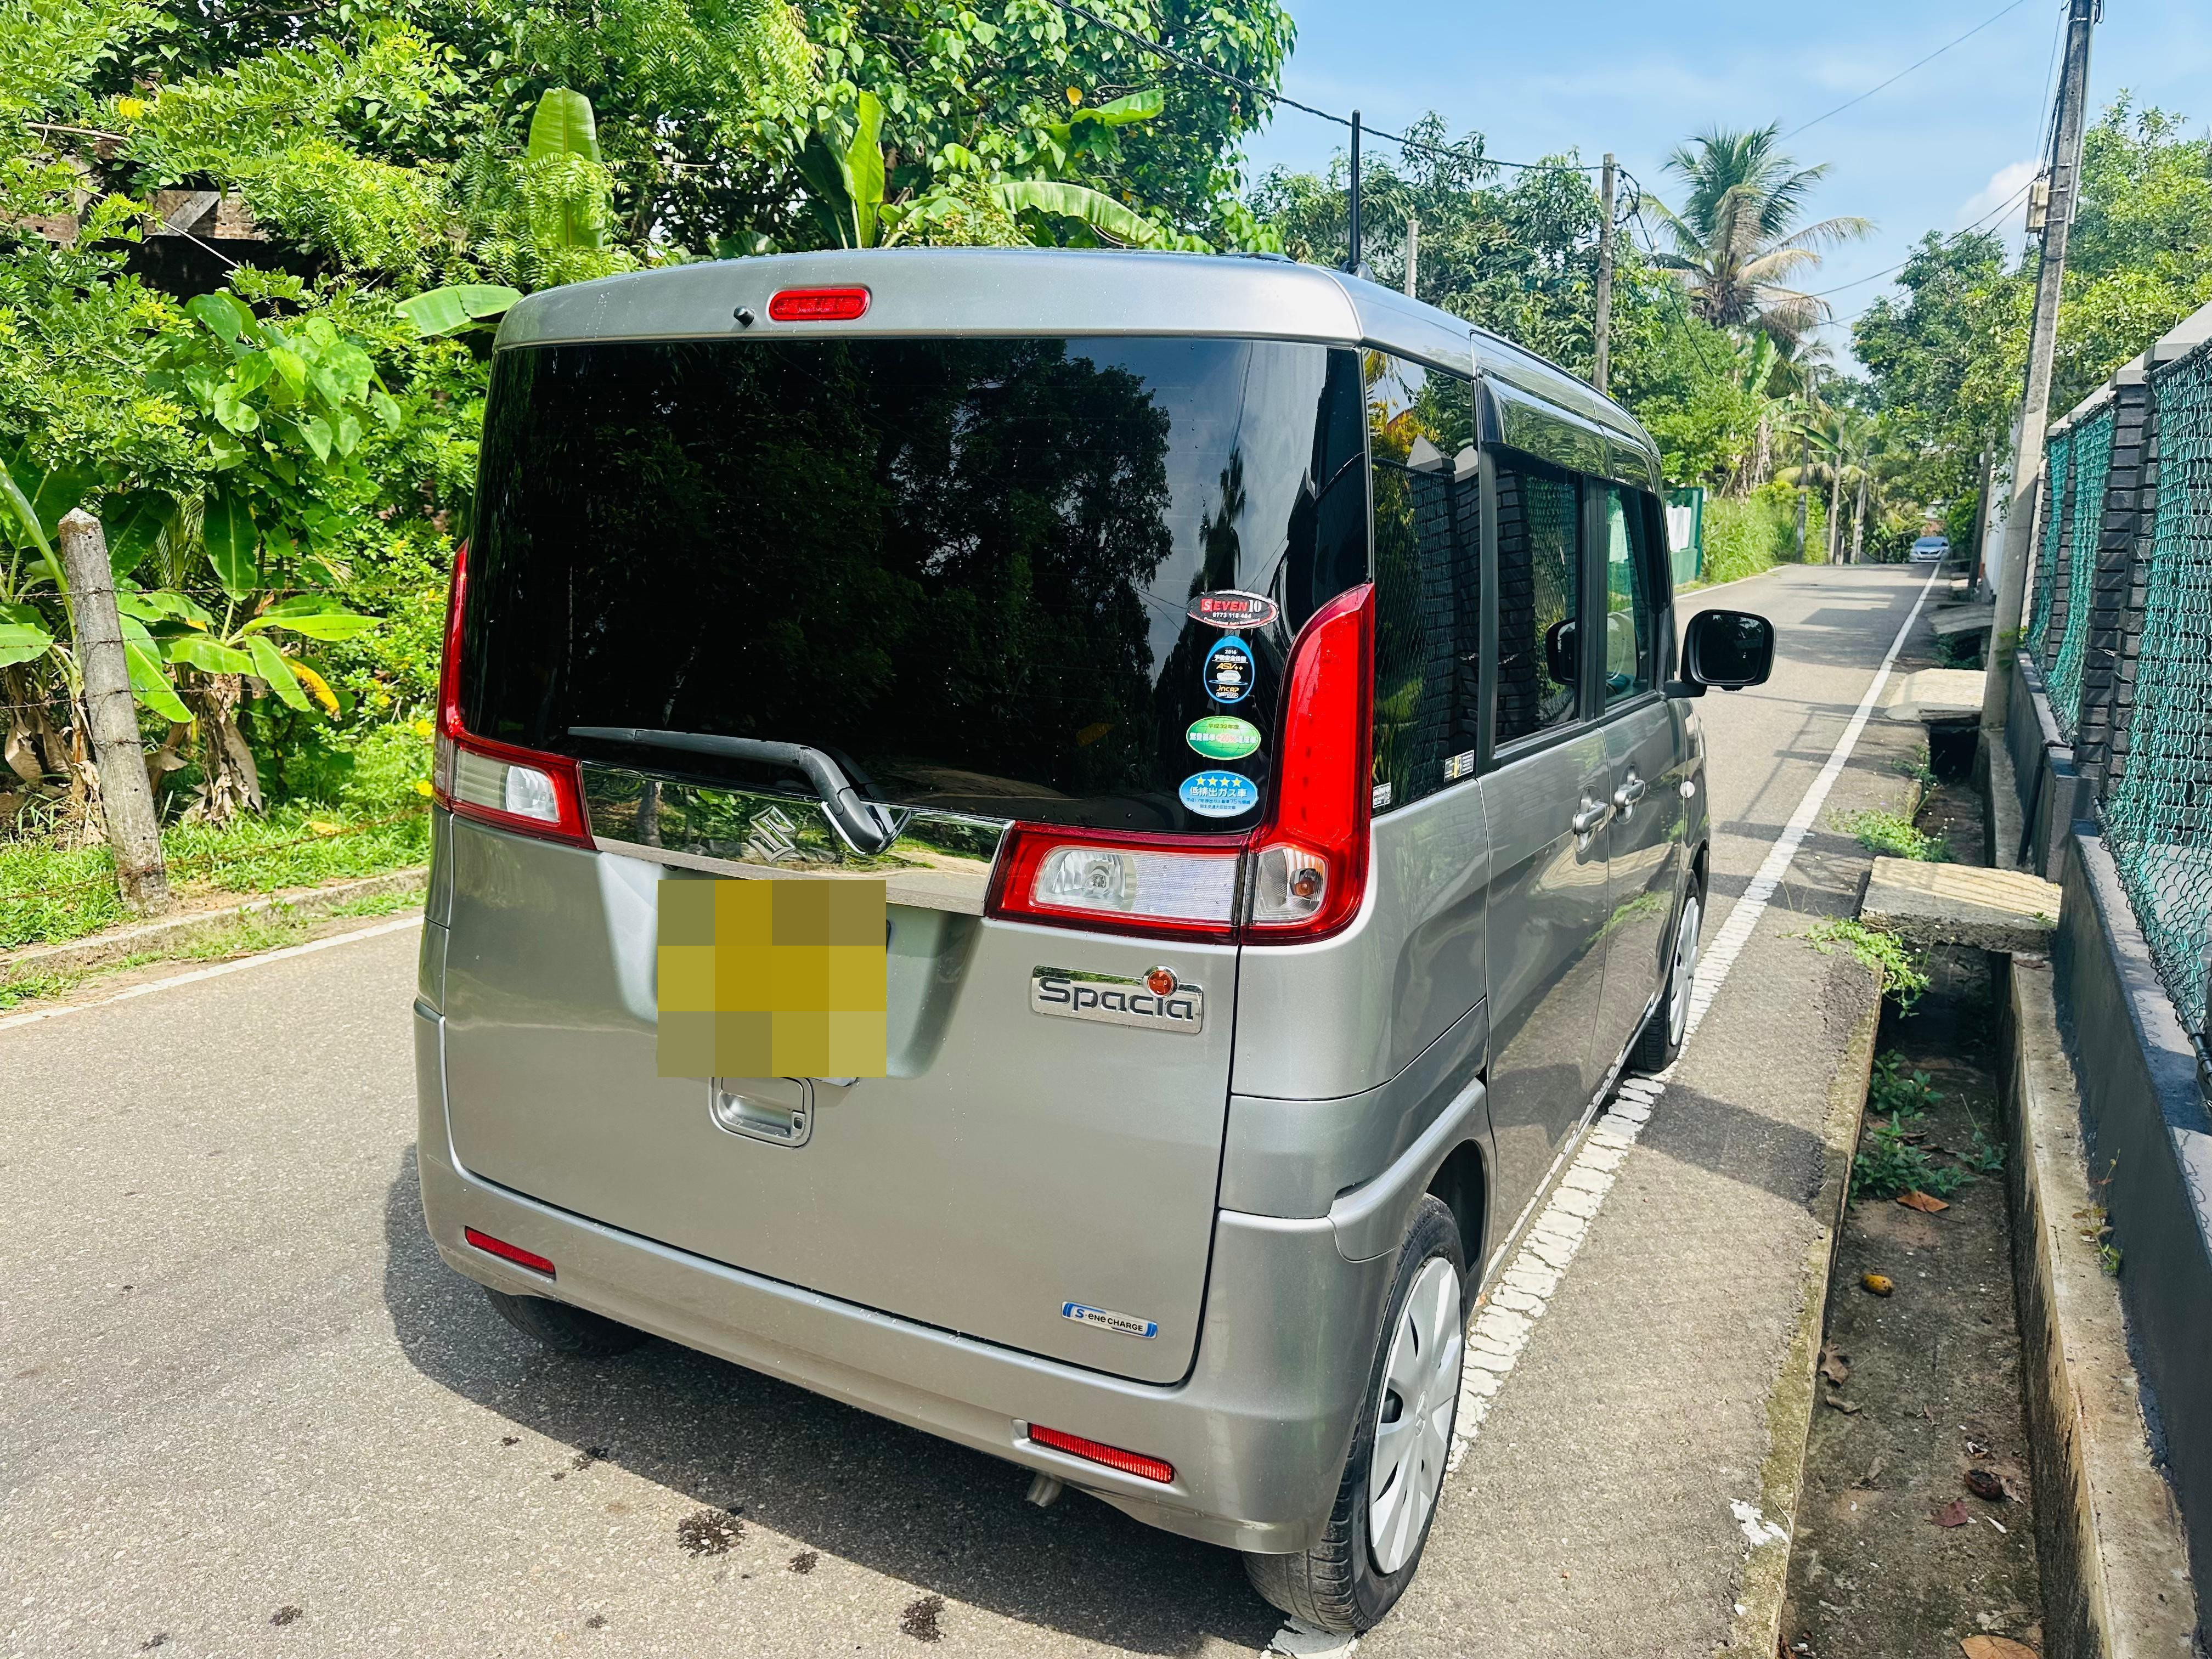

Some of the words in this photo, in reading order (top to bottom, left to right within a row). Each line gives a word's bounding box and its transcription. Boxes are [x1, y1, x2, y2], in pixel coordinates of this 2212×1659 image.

[1189, 786, 1248, 798] 低排出ガス車
[1039, 975, 1193, 1022] Spacia
[1107, 1318, 1143, 1331] CHARGE
